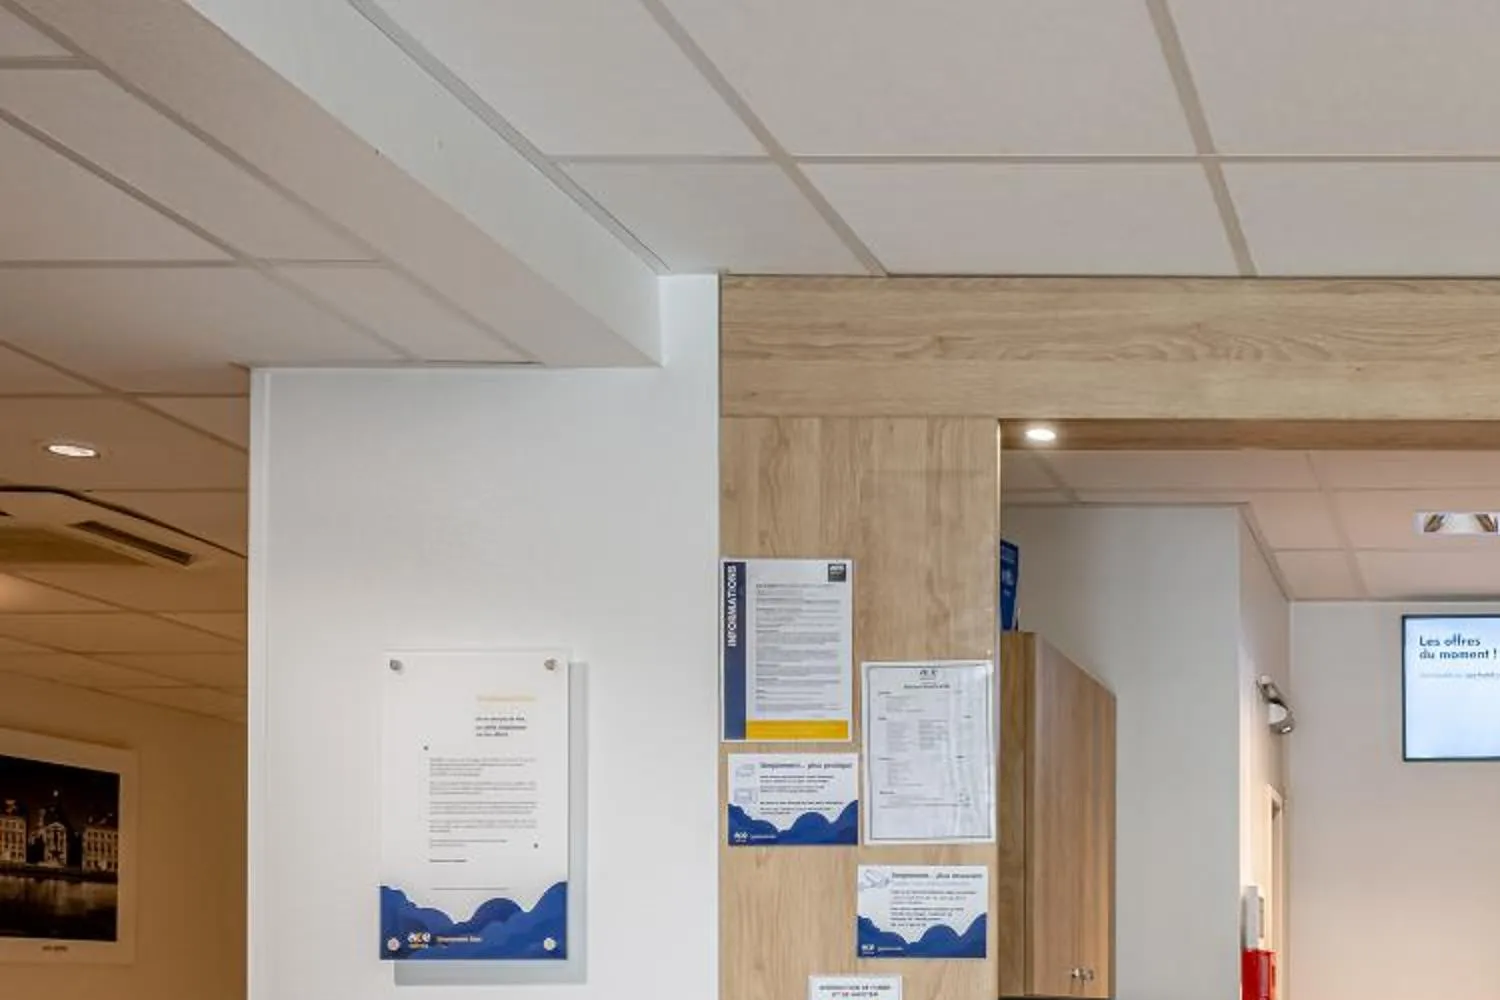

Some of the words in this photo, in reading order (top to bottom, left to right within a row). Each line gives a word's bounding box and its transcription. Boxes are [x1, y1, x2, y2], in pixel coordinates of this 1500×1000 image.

[727, 564, 737, 647] INFORMATIONS
[1419, 635, 1441, 647] Les
[1444, 633, 1481, 647] offres
[1419, 648, 1435, 659] du
[1439, 649, 1489, 659] moment
